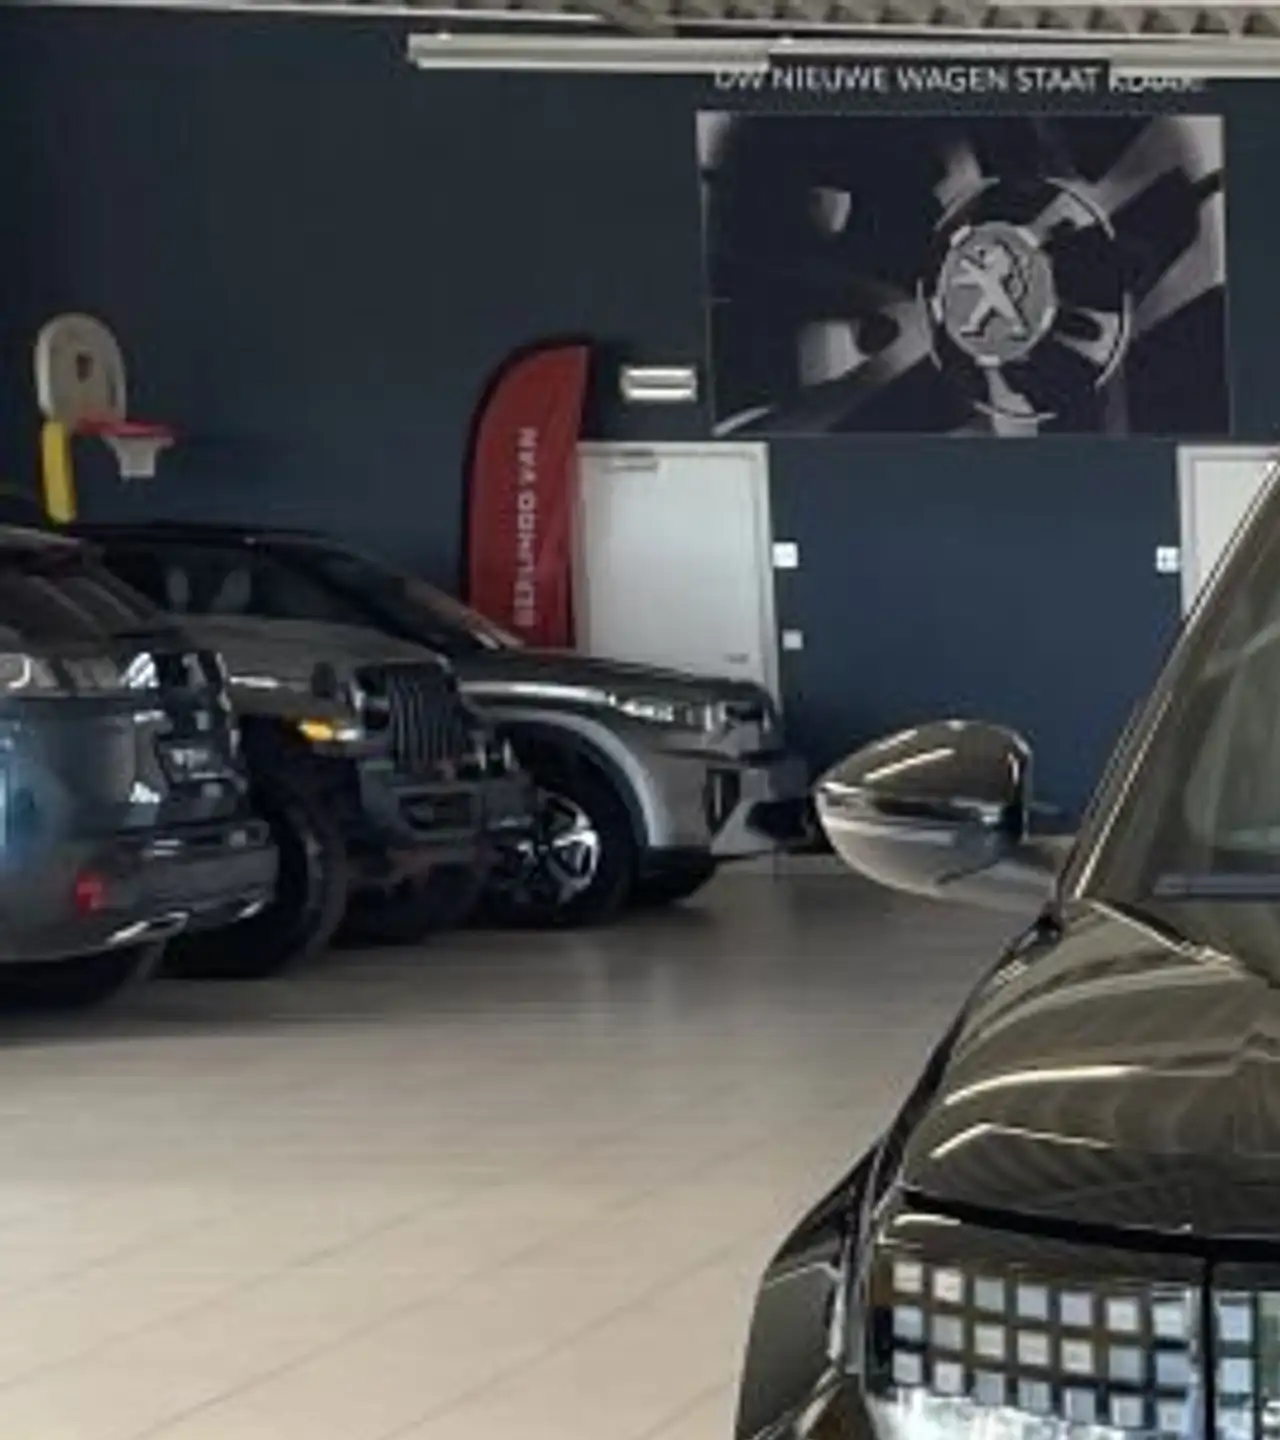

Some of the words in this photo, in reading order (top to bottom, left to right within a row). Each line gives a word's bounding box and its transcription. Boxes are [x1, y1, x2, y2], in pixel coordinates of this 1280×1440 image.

[772, 64, 889, 93] NIEUWE
[896, 65, 1009, 94] WAGEN
[1016, 66, 1098, 93] STAAT
